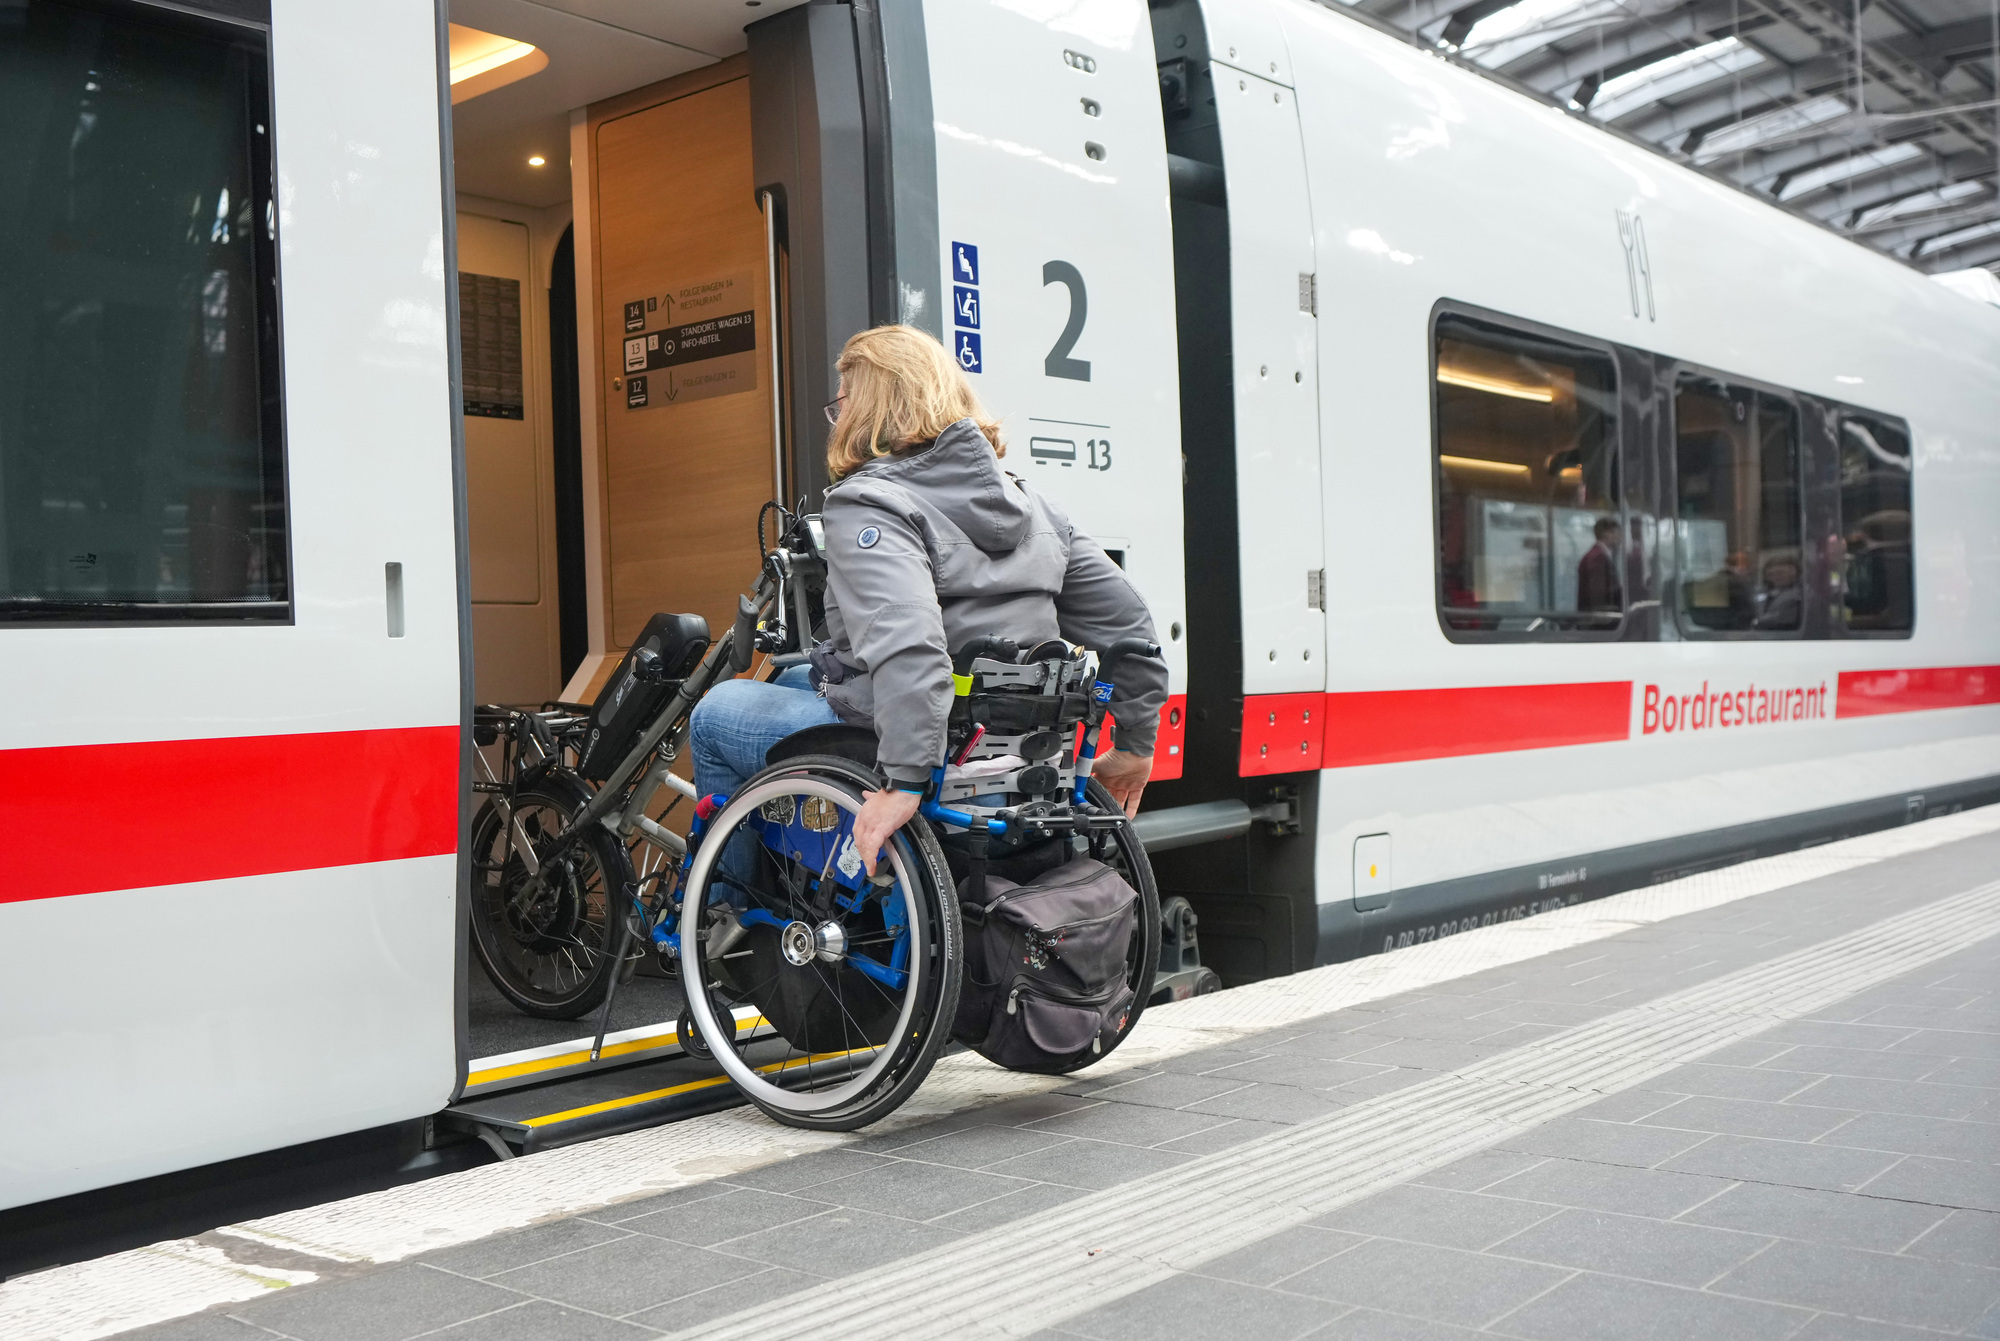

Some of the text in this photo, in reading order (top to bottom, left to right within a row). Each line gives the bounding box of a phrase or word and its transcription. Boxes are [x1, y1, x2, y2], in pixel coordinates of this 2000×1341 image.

[680, 279, 733, 298] FOLGEWAGEN 14
[680, 293, 722, 310] RESTAURANT
[629, 304, 640, 318] 14
[681, 314, 752, 337] STANDORT: WAGEN 13
[1043, 259, 1091, 382] 2
[631, 343, 641, 355] 13
[681, 333, 721, 349] INFO-ABTEIL
[632, 380, 642, 393] 12
[1087, 438, 1112, 471] 13
[1643, 680, 1827, 735] Bordrestaurant
